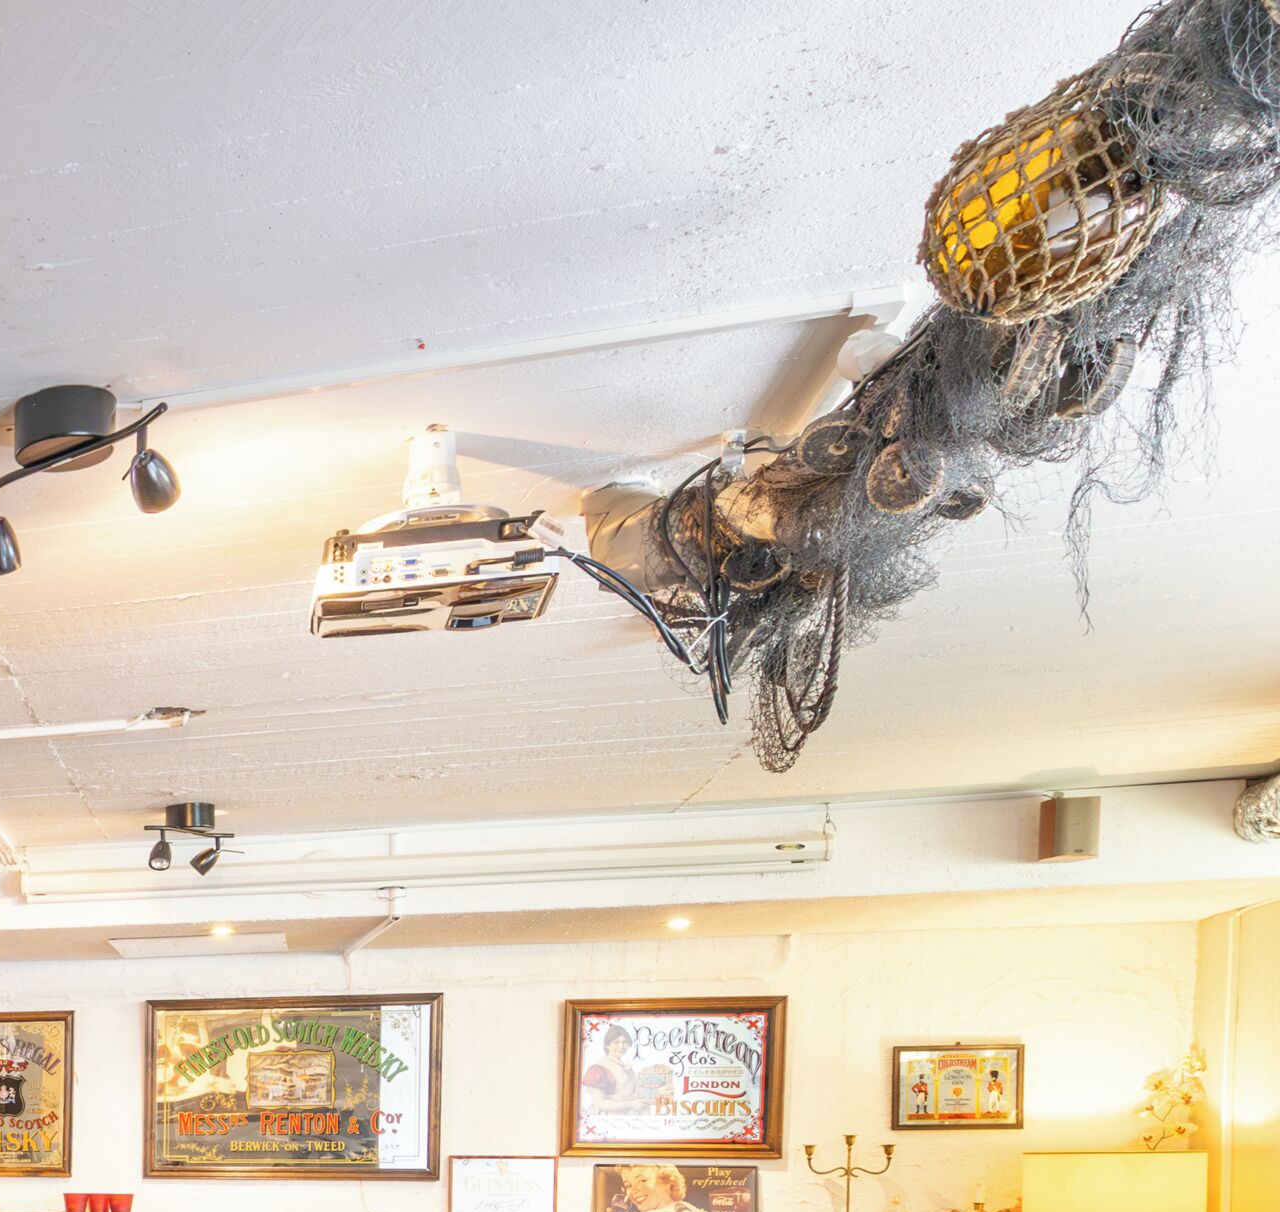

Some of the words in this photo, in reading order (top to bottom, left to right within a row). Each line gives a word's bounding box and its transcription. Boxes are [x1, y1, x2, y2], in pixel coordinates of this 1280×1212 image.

[12, 1039, 61, 1076] REGAL
[175, 1036, 236, 1083] FINEST
[232, 1024, 271, 1050] OLD
[271, 1019, 340, 1048] SCOTCH
[339, 1025, 410, 1083] WHISKY
[698, 1021, 762, 1085] Frean
[683, 1077, 741, 1091] LONDON
[9, 1110, 59, 1130] SCOTCH
[260, 1111, 339, 1136] RENTON
[347, 1116, 360, 1135] &
[692, 1177, 747, 1190] refreshed
[707, 1167, 731, 1178] Play
